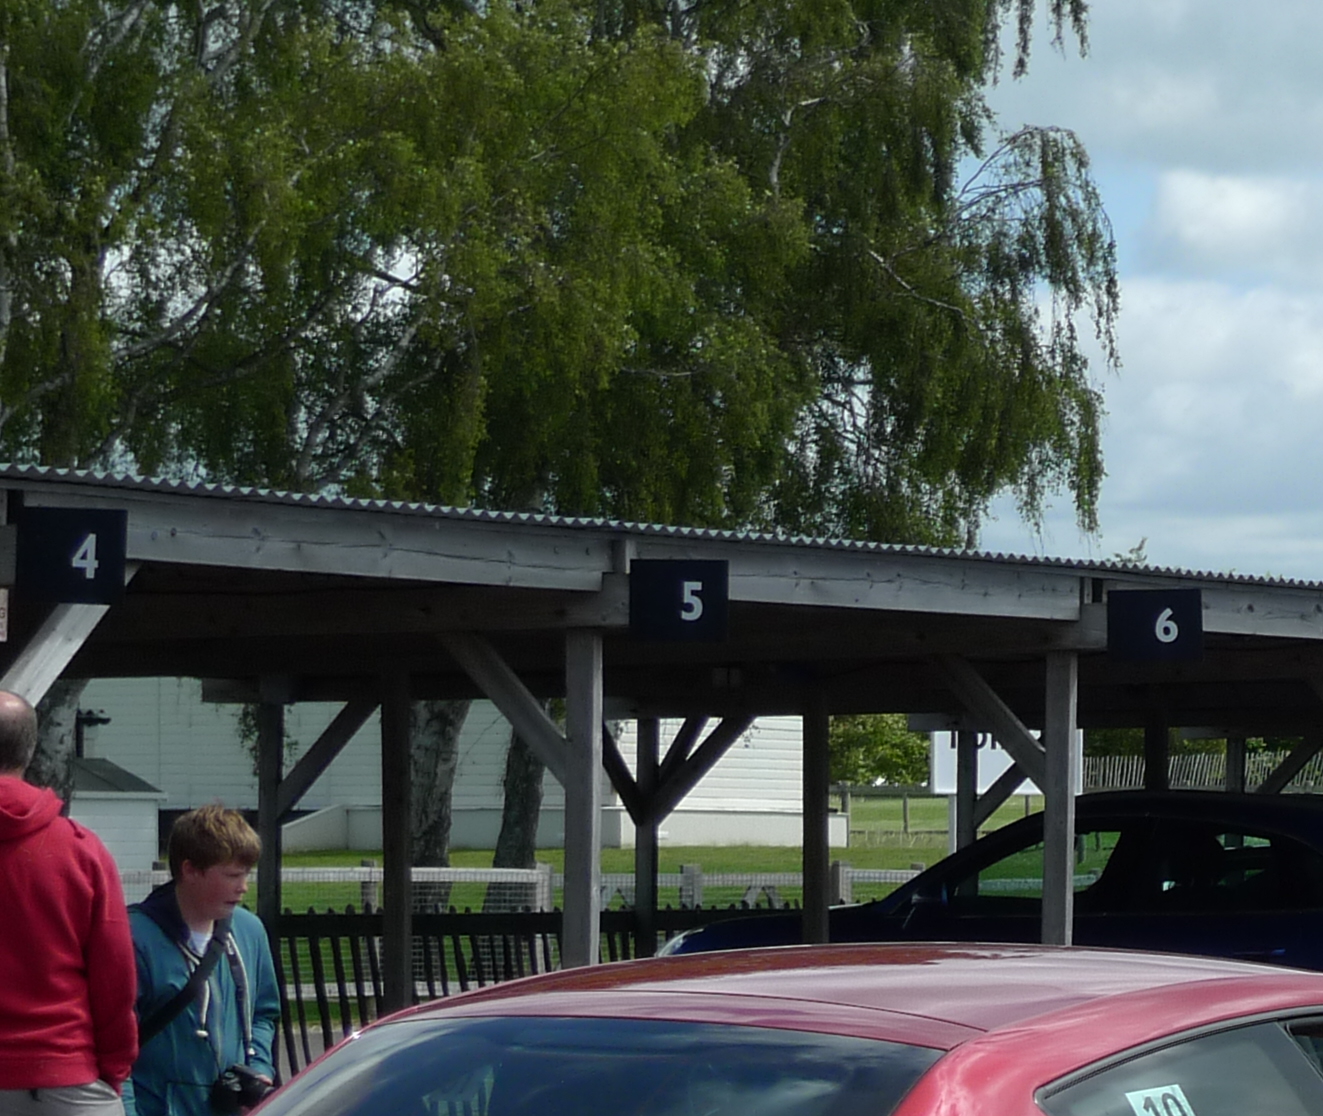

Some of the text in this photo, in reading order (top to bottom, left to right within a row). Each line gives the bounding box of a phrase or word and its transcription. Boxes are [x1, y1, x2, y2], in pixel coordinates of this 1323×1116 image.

[72, 534, 98, 579] 4
[681, 582, 703, 621] 5
[1155, 608, 1179, 643] 6
